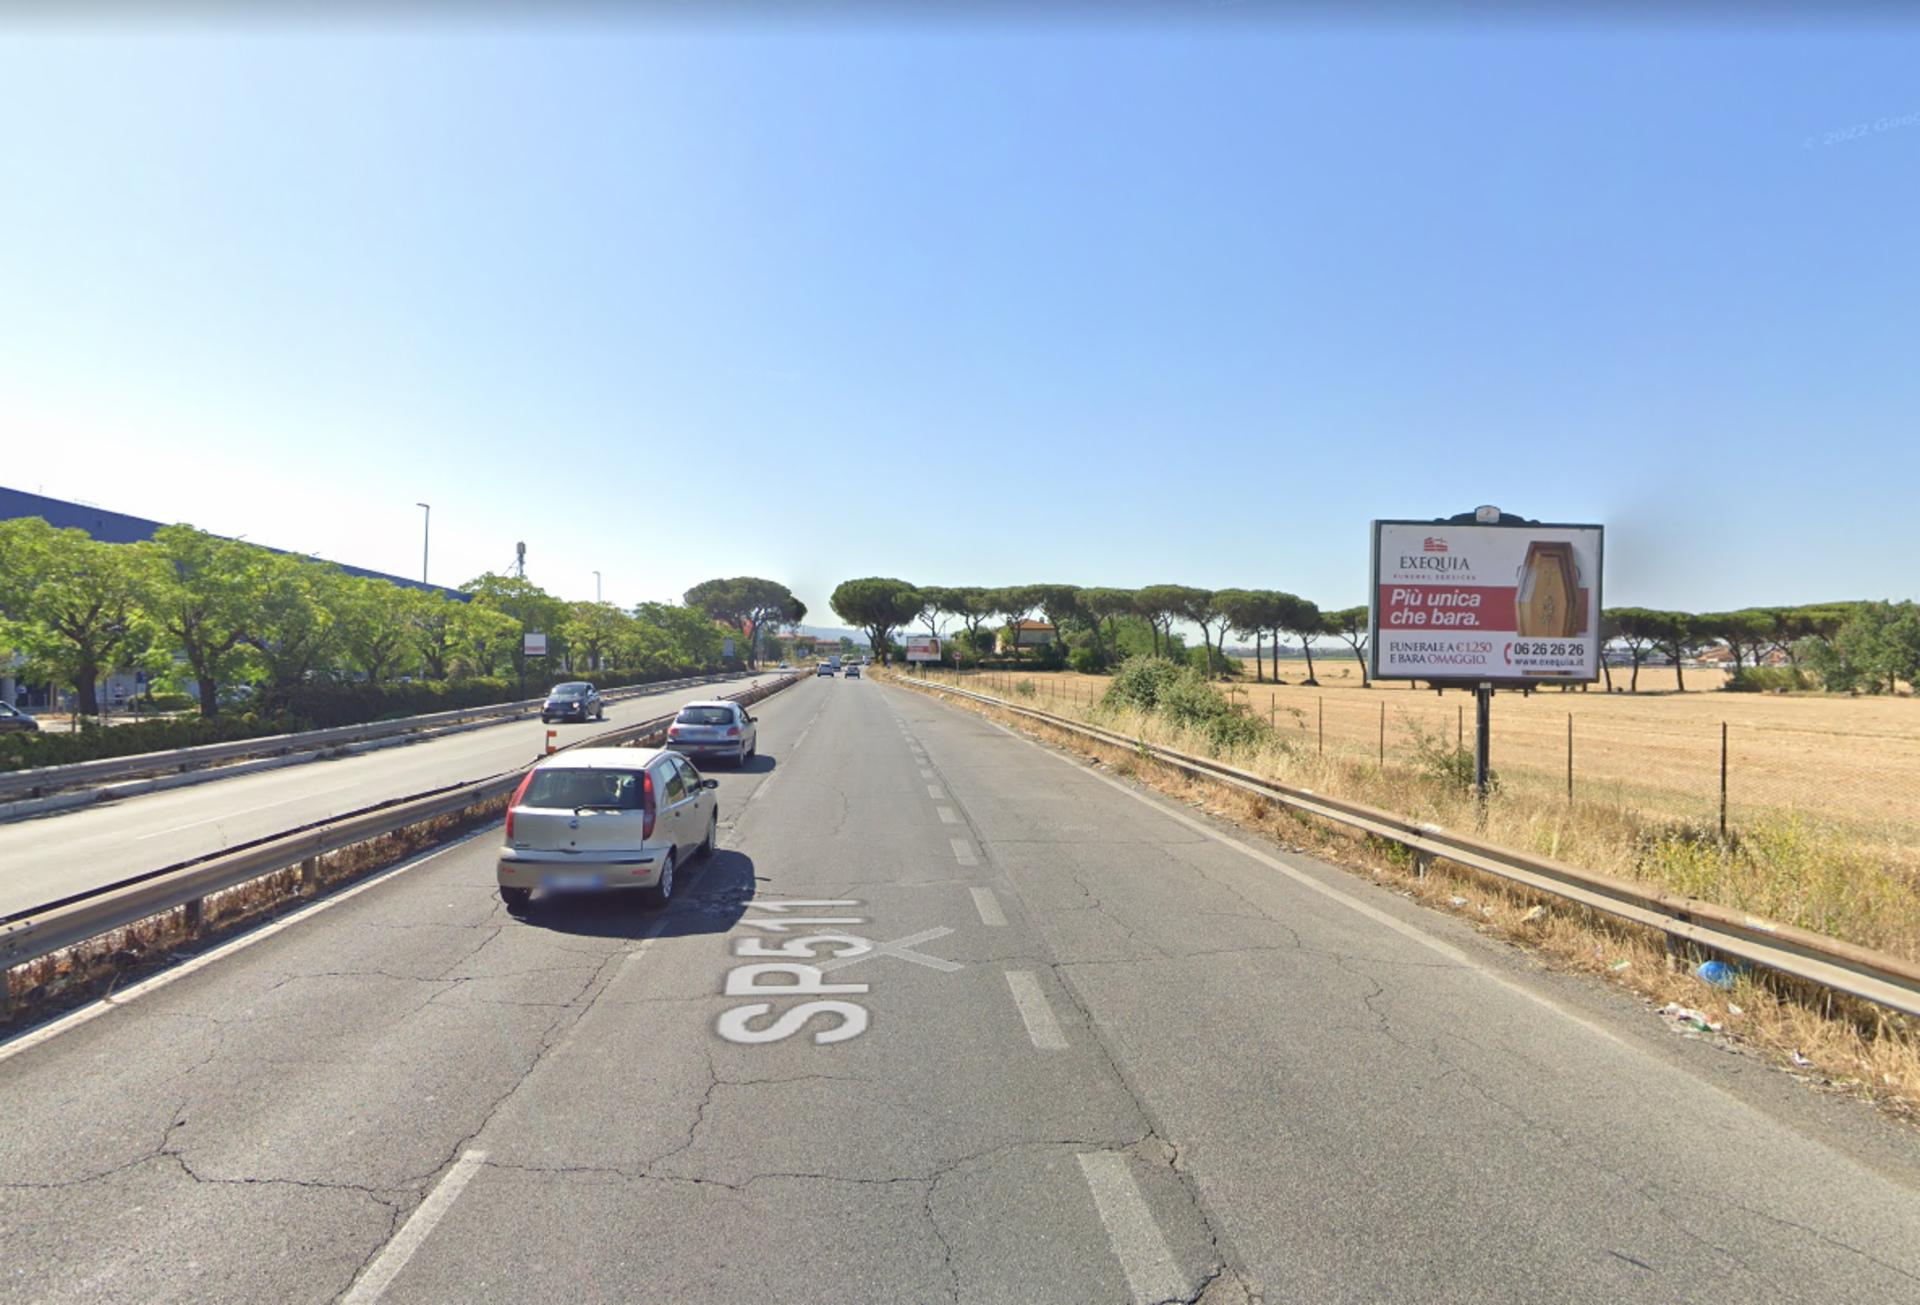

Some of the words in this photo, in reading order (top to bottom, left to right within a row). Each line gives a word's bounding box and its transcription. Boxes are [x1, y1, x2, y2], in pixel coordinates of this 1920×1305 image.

[1400, 556, 1470, 572] EXEQUIA
[1391, 588, 1423, 606] Più
[1427, 589, 1481, 607] unica
[1390, 607, 1427, 625] che
[1430, 607, 1480, 626] bara.
[1390, 642, 1445, 652] FUNERALE
[1447, 642, 1455, 652] A
[1514, 642, 1530, 655] 06
[1532, 642, 1548, 655] 26
[1550, 643, 1566, 656] 26
[1568, 643, 1584, 656] 26
[1390, 654, 1396, 663] E
[1398, 654, 1426, 664] BARA
[1514, 658, 1584, 667] www.exequia.it
